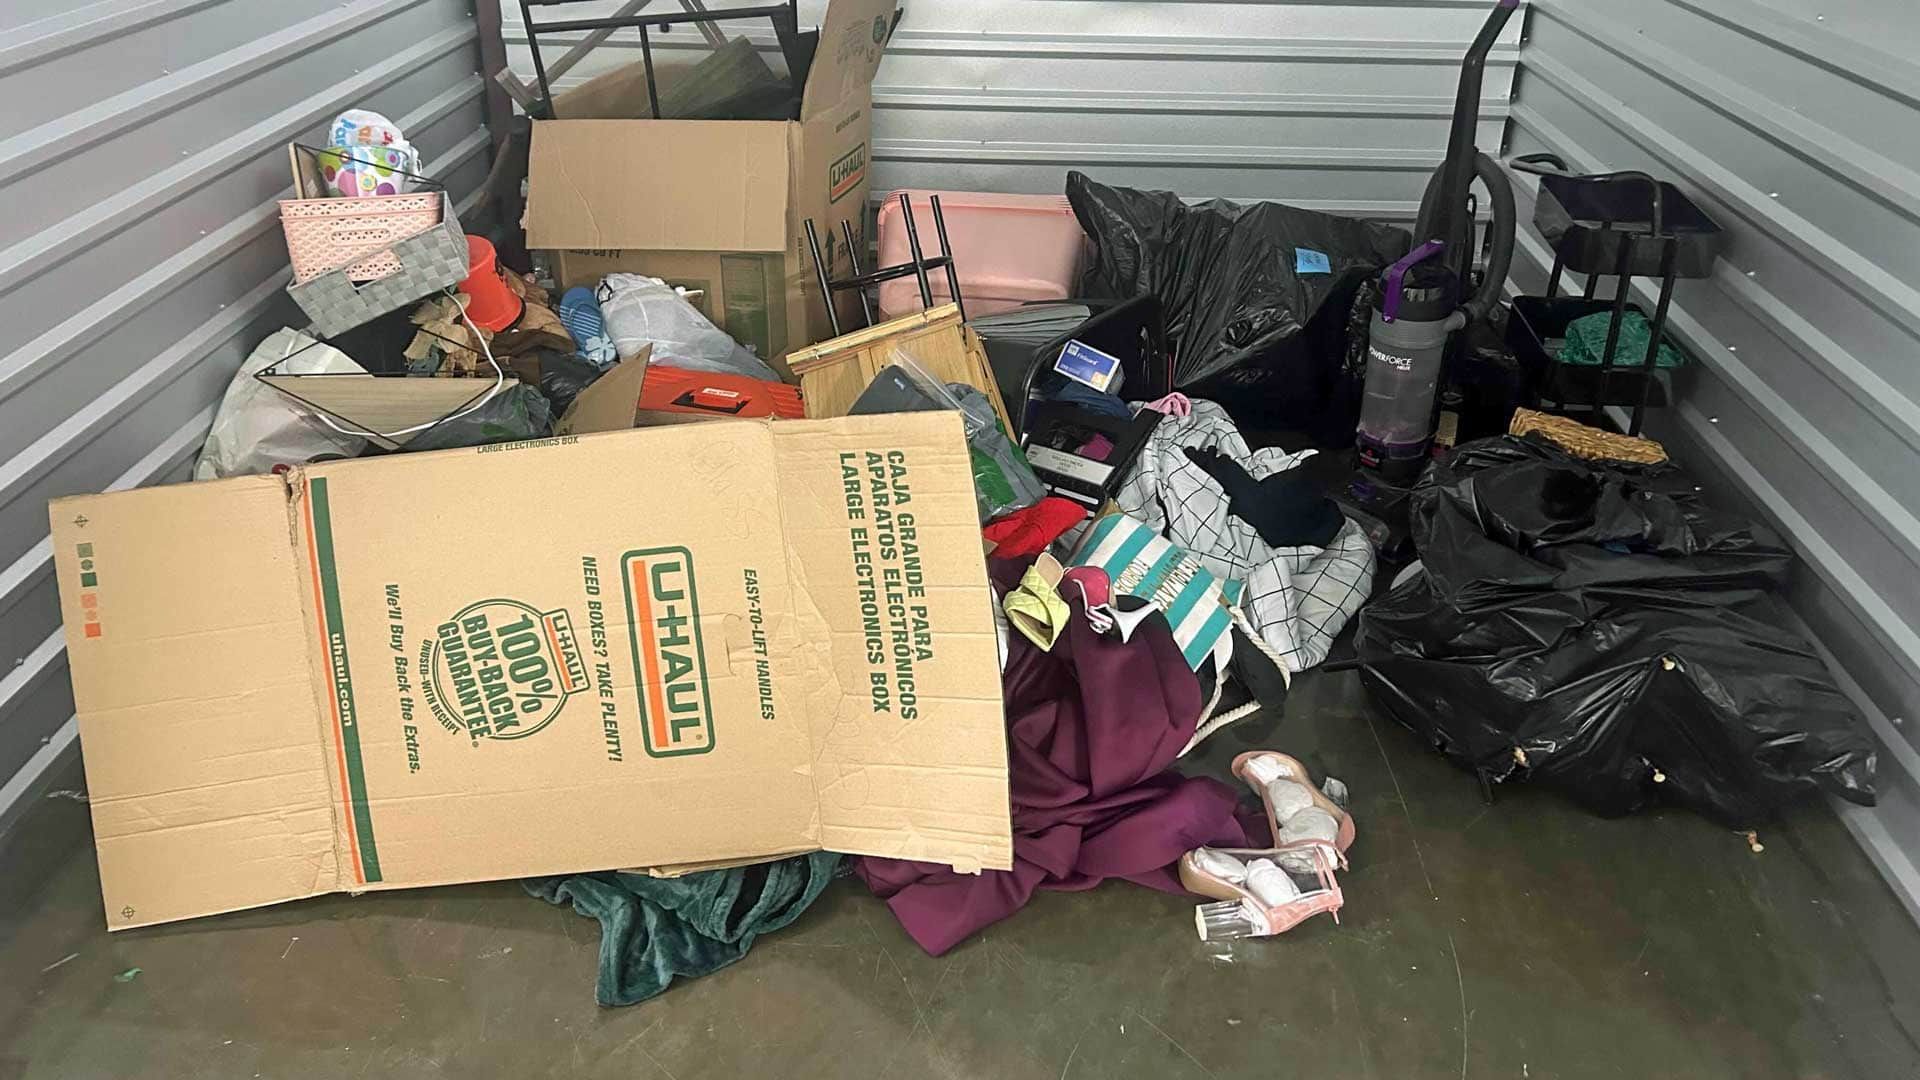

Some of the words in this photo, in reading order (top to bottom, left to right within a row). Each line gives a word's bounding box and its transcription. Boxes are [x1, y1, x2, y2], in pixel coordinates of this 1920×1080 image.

[832, 152, 864, 187] U-HAUL
[477, 443, 504, 454] LARGE
[505, 438, 560, 451] ELECTRONICS
[561, 436, 579, 446] BOX
[840, 453, 865, 520] LARGE
[887, 451, 911, 505] CAJA
[582, 556, 600, 595] NEED
[897, 513, 925, 597] GRANDE
[386, 584, 402, 620] We'll
[851, 528, 884, 664] ELECTRONICS
[866, 451, 897, 560] APARATOS
[883, 569, 918, 719] ELECTRÓNICOS
[390, 624, 404, 652] Buy
[552, 614, 583, 688] U-HAUL
[588, 601, 608, 657] BOXES?
[652, 562, 699, 742] U-HAUL
[744, 569, 767, 656] EASY-TO-LIFT
[756, 660, 775, 720] HANDLES
[910, 606, 933, 661] PARA
[331, 633, 352, 727] uhaul.com
[395, 656, 411, 693] Back
[462, 614, 520, 735] BUY-BACK
[496, 614, 558, 713] 100%
[596, 662, 614, 698] TAKE
[400, 697, 414, 720] the
[870, 673, 890, 712] BOX
[431, 706, 461, 735] RECEIPT
[601, 702, 622, 762] PLENTY!
[404, 725, 420, 774] Extras.
